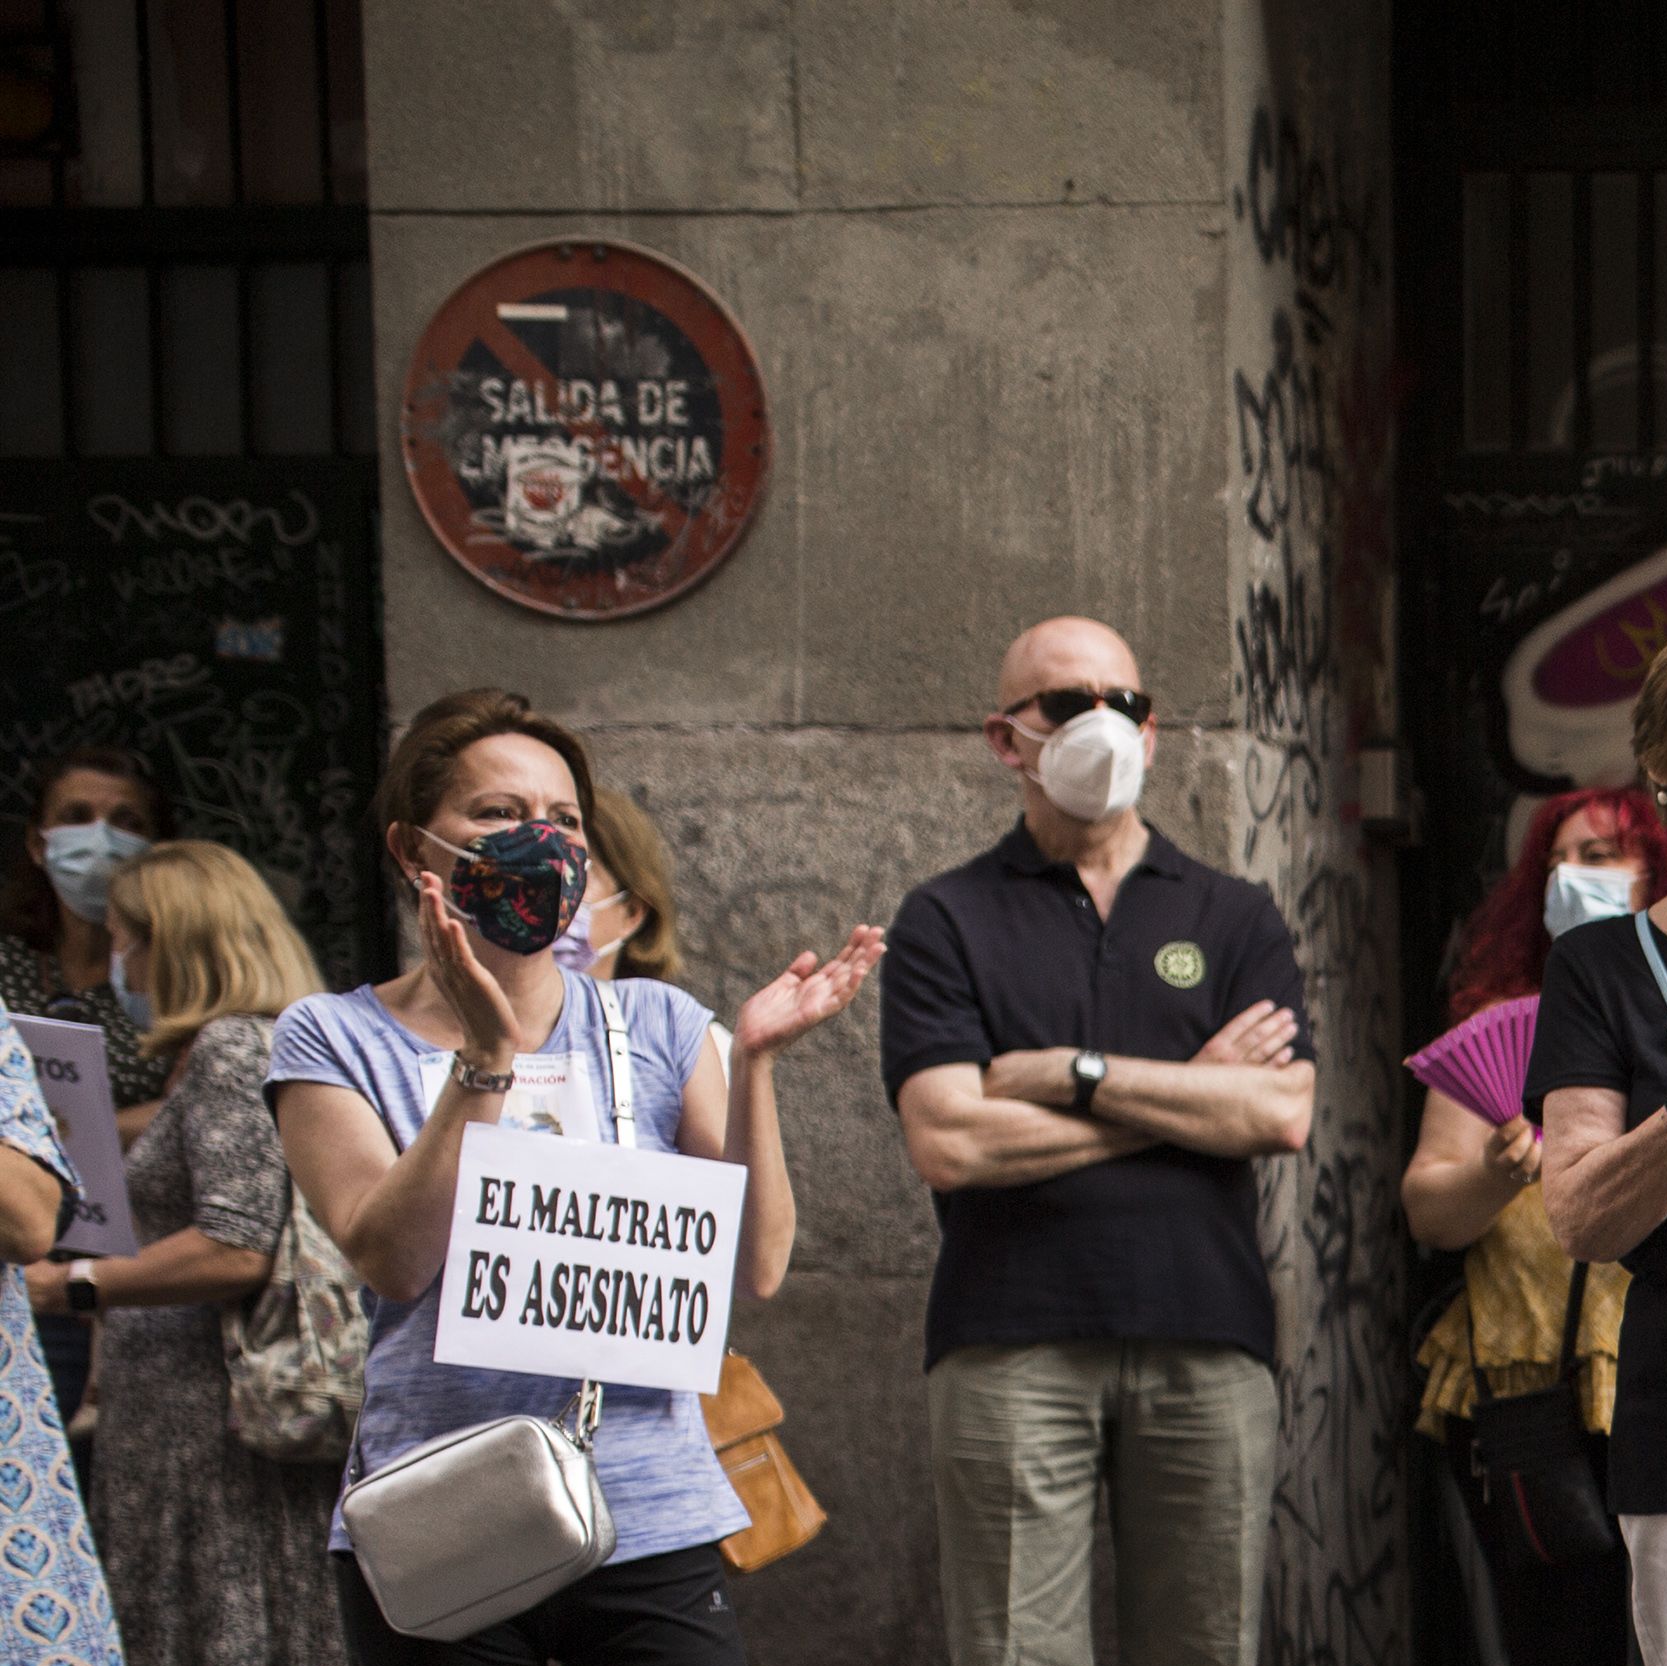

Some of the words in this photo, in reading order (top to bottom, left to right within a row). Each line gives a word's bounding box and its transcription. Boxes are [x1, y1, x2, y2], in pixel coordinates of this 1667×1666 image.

[480, 378, 624, 424] SALIDA
[637, 380, 690, 425] DE
[457, 434, 714, 482] MGENCIA
[476, 1176, 521, 1229] EL
[528, 1184, 717, 1255] MALTRATO
[461, 1250, 511, 1321] ES
[518, 1258, 709, 1345] ASESINATO
